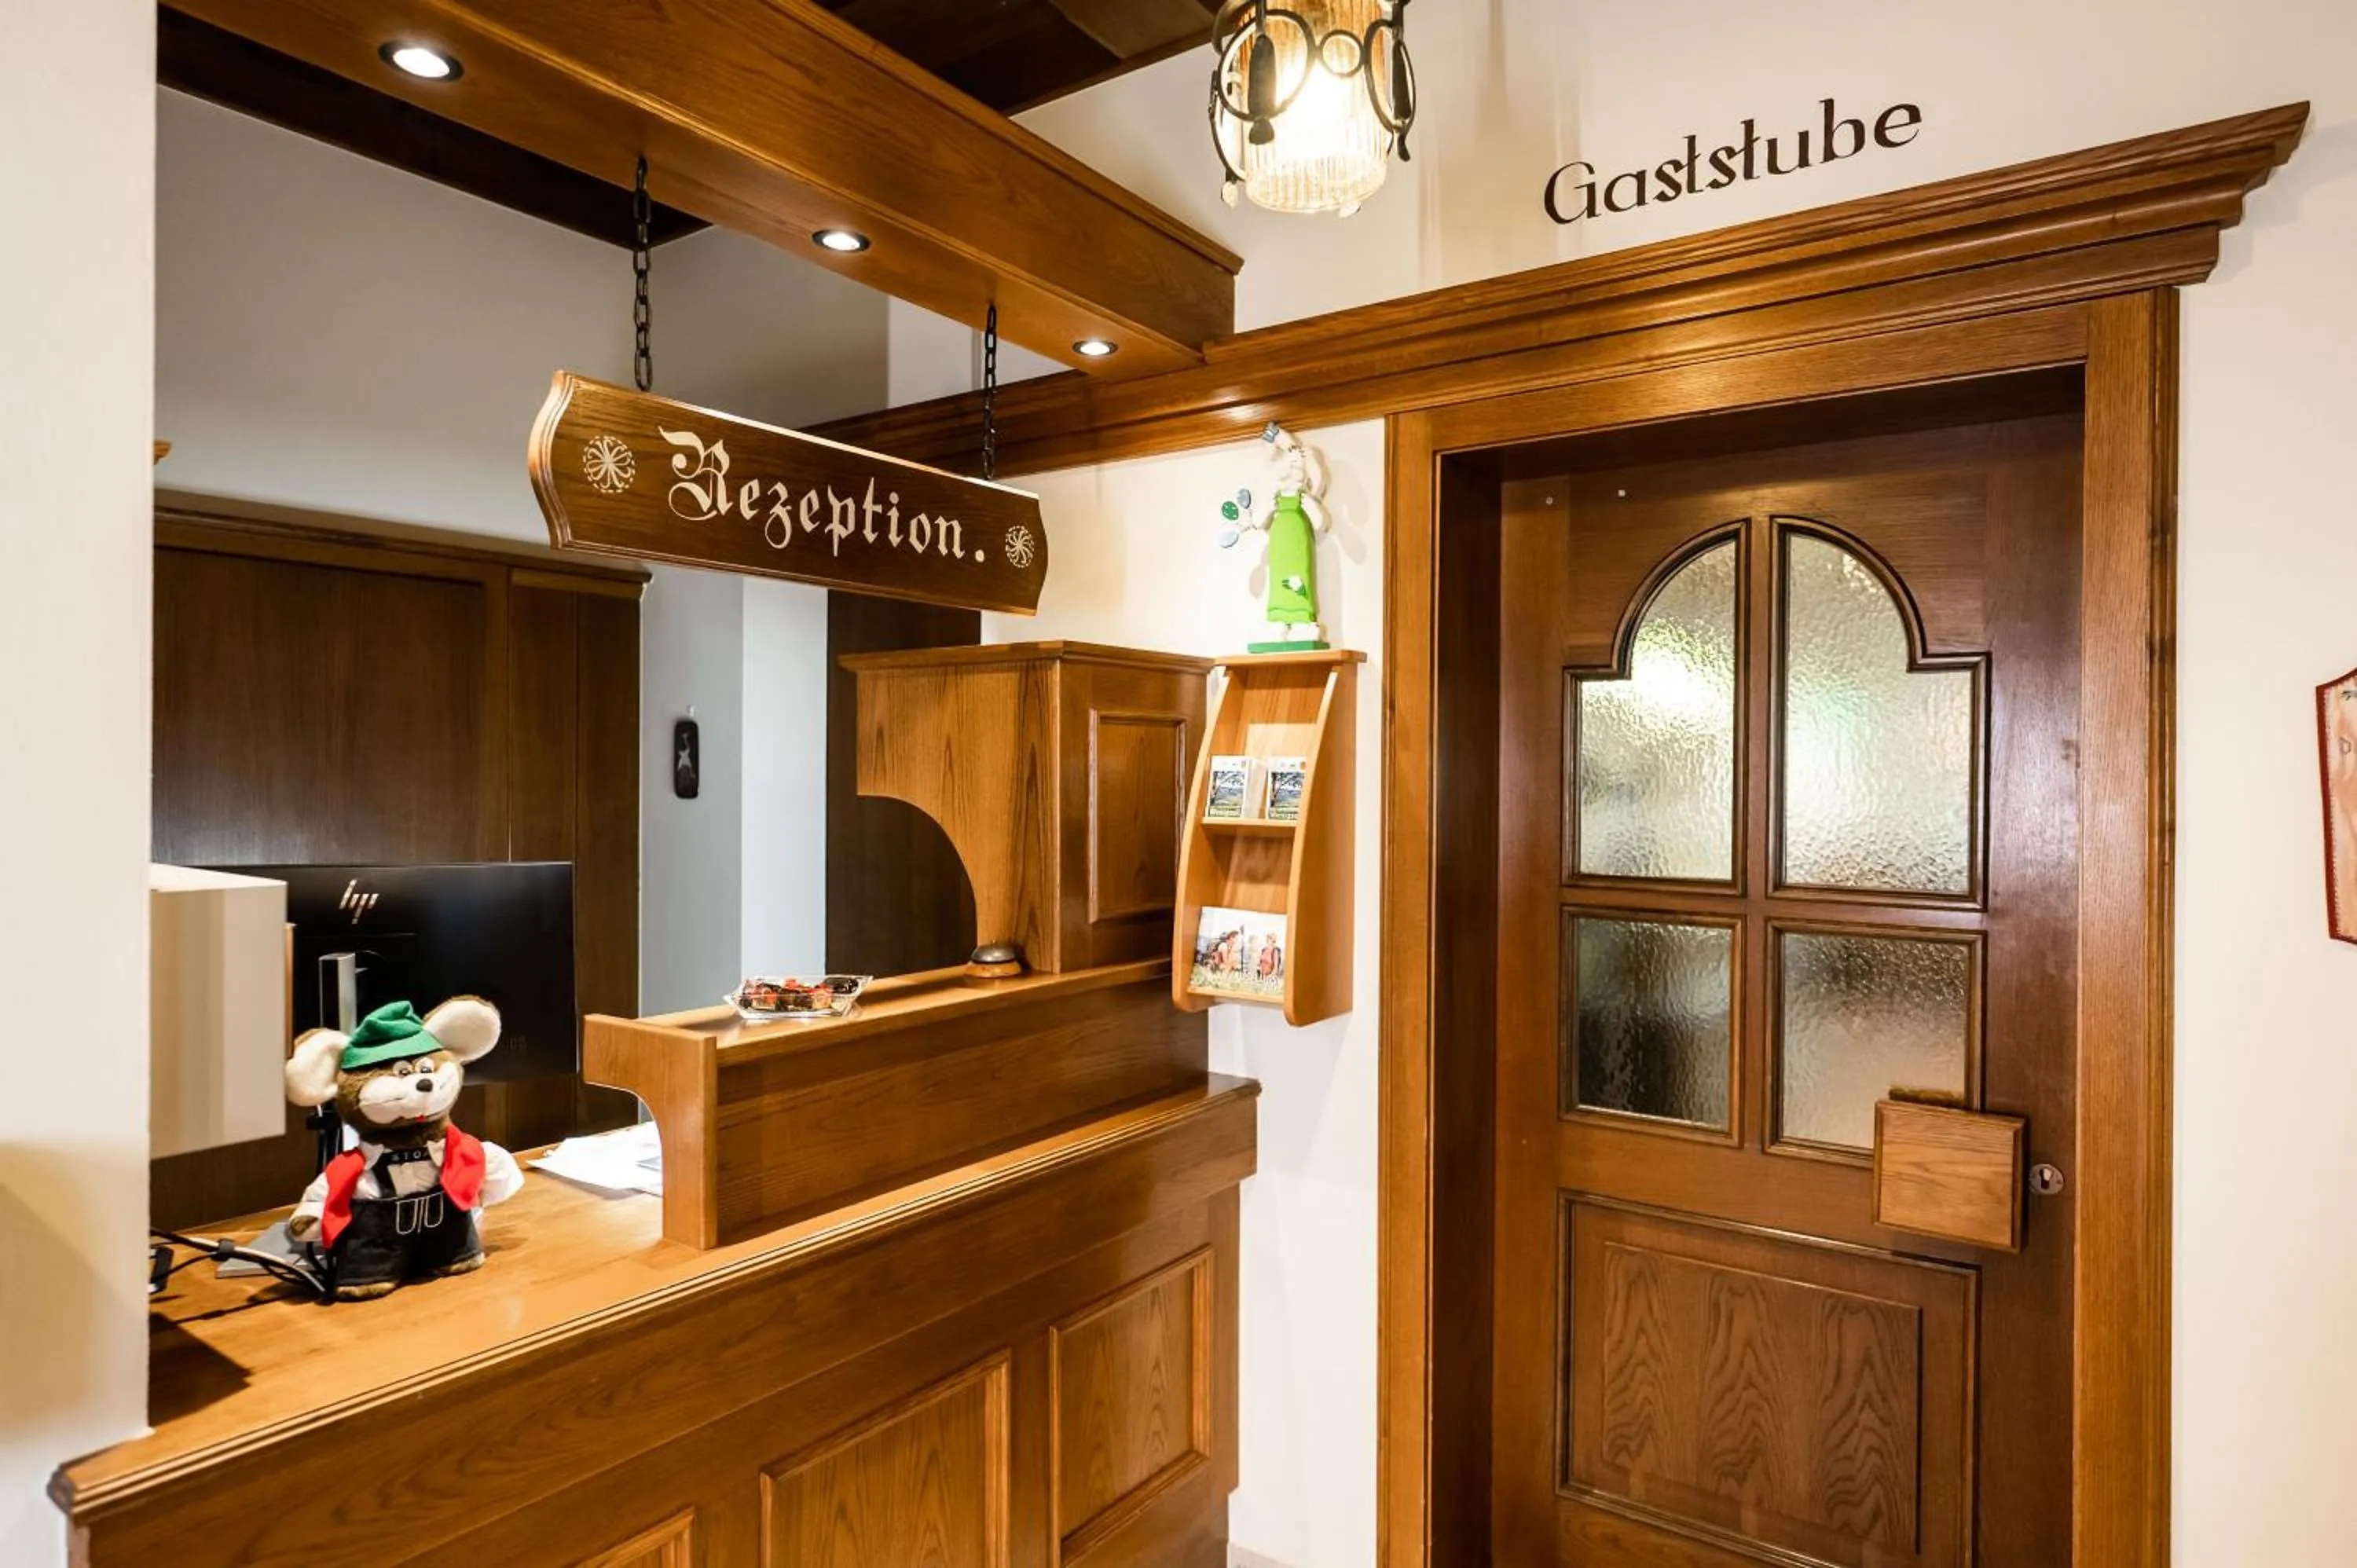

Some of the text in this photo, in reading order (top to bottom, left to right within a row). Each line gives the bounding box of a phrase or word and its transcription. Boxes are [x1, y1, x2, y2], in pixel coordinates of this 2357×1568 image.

[1544, 97, 1923, 225] Gaststube
[658, 425, 985, 562] Rezeption.
[339, 878, 379, 925] hp
